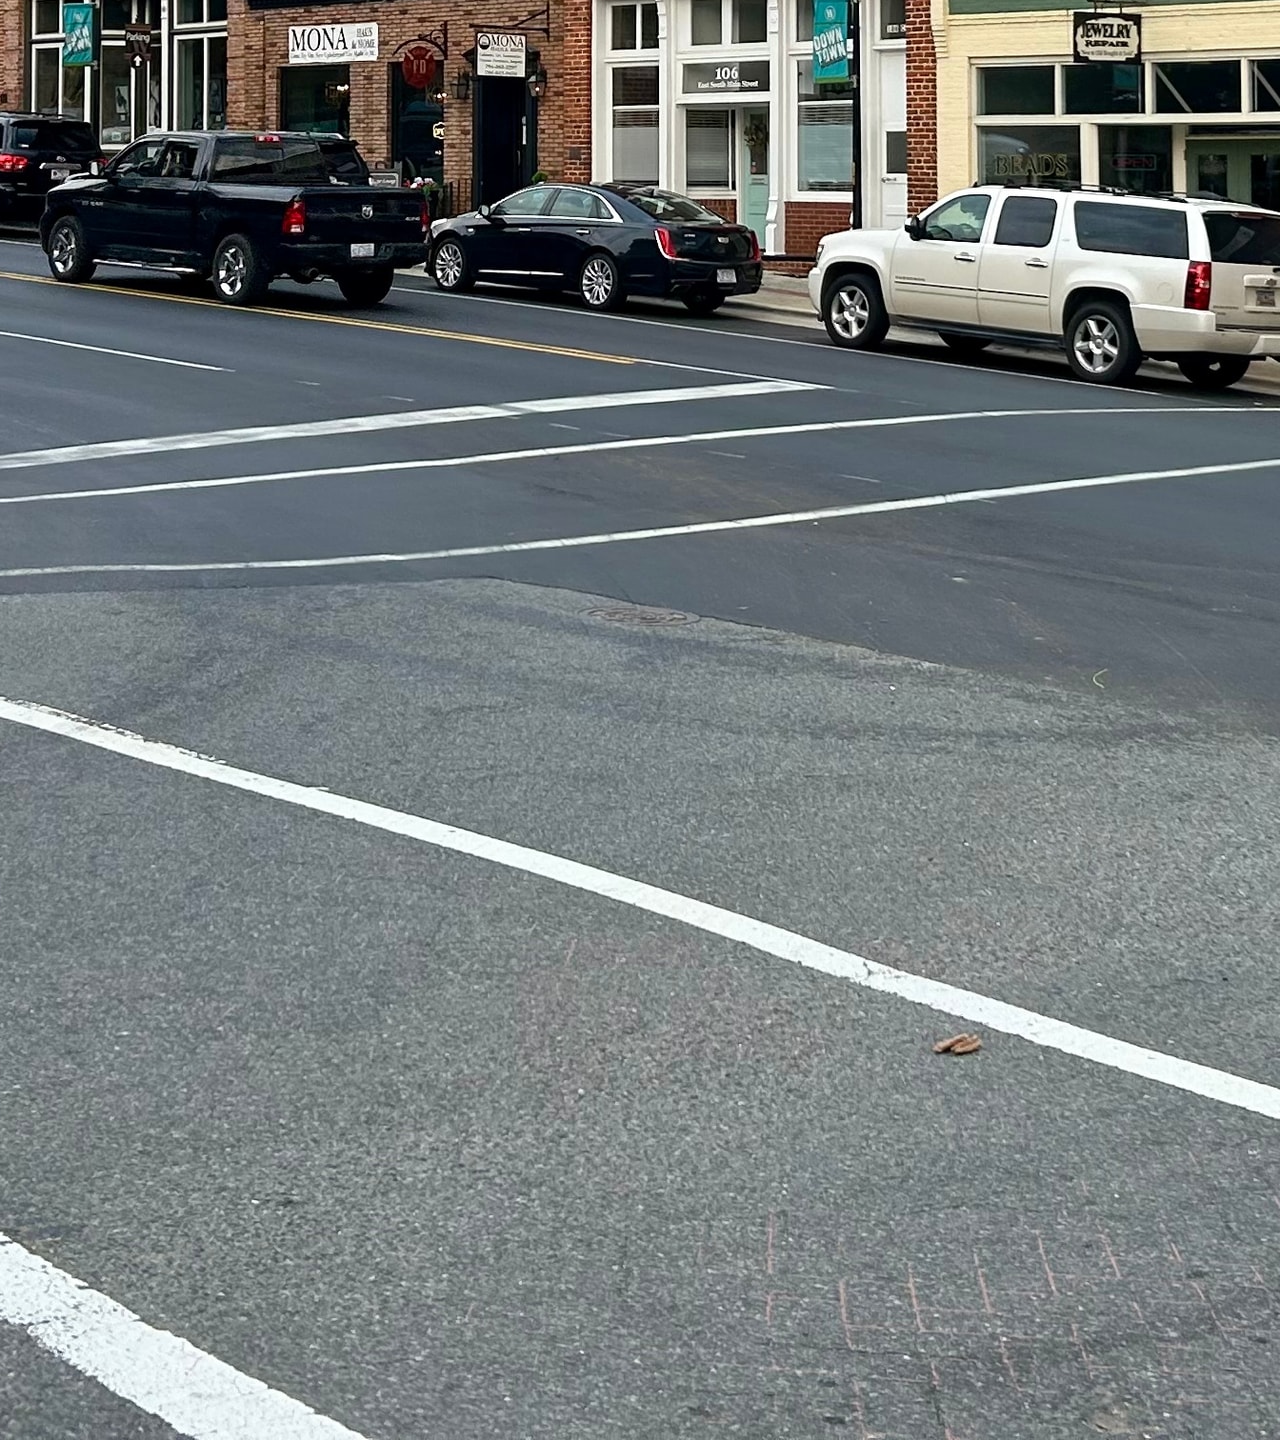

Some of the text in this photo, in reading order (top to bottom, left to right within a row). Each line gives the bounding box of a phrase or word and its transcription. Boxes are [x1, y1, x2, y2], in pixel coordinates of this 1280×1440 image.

[1081, 23, 1133, 38] JEWELRY
[126, 32, 150, 44] Parking
[291, 27, 348, 52] MONA
[491, 34, 524, 48] MONA
[813, 26, 844, 51] DOWN
[1085, 40, 1130, 48] REPAIR
[816, 41, 847, 63] TOWN
[715, 67, 739, 80] 106
[697, 81, 710, 89] East
[710, 80, 726, 88] South
[741, 80, 759, 88] Street
[994, 153, 1069, 176] BEADS
